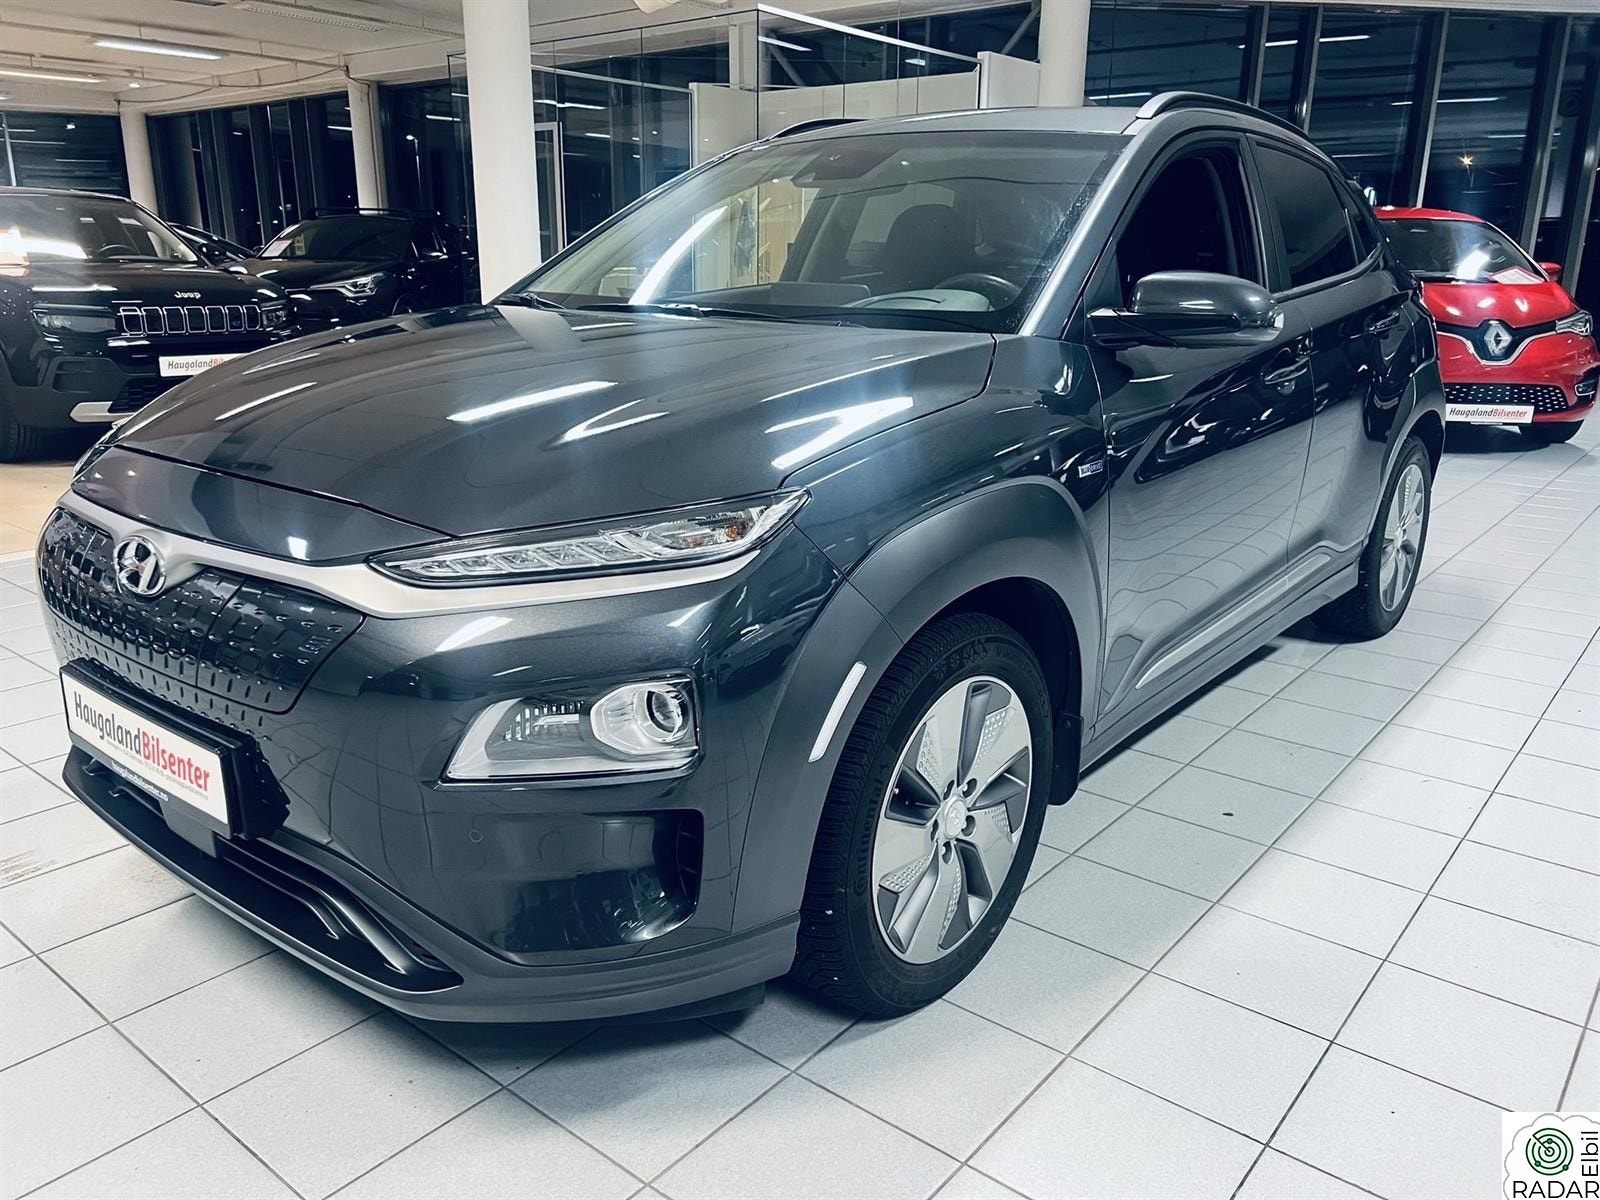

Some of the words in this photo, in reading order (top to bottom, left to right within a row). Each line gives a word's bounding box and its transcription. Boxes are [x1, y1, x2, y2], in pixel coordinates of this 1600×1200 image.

[174, 290, 201, 299] Jeep
[1449, 407, 1527, 419] HaugalandBilsenter
[73, 691, 210, 792] HaugalandBilsenter
